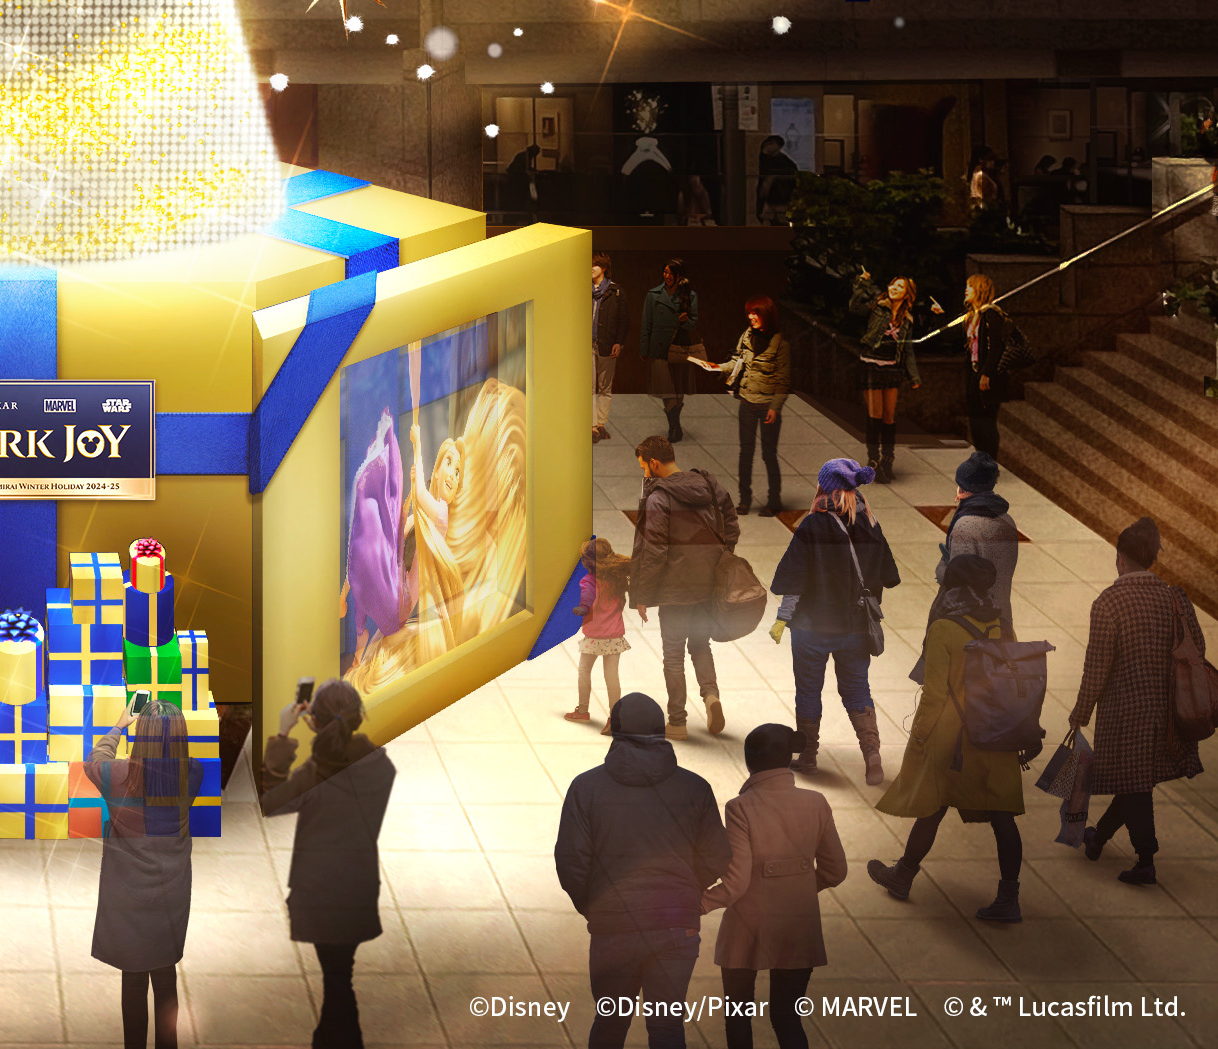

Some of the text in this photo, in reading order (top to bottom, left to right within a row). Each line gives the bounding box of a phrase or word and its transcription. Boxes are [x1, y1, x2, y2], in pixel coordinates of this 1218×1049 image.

[44, 399, 76, 412] MARVEL
[102, 405, 131, 413] WARS
[63, 424, 132, 463] JOY
[86, 482, 120, 490] 2024-25
